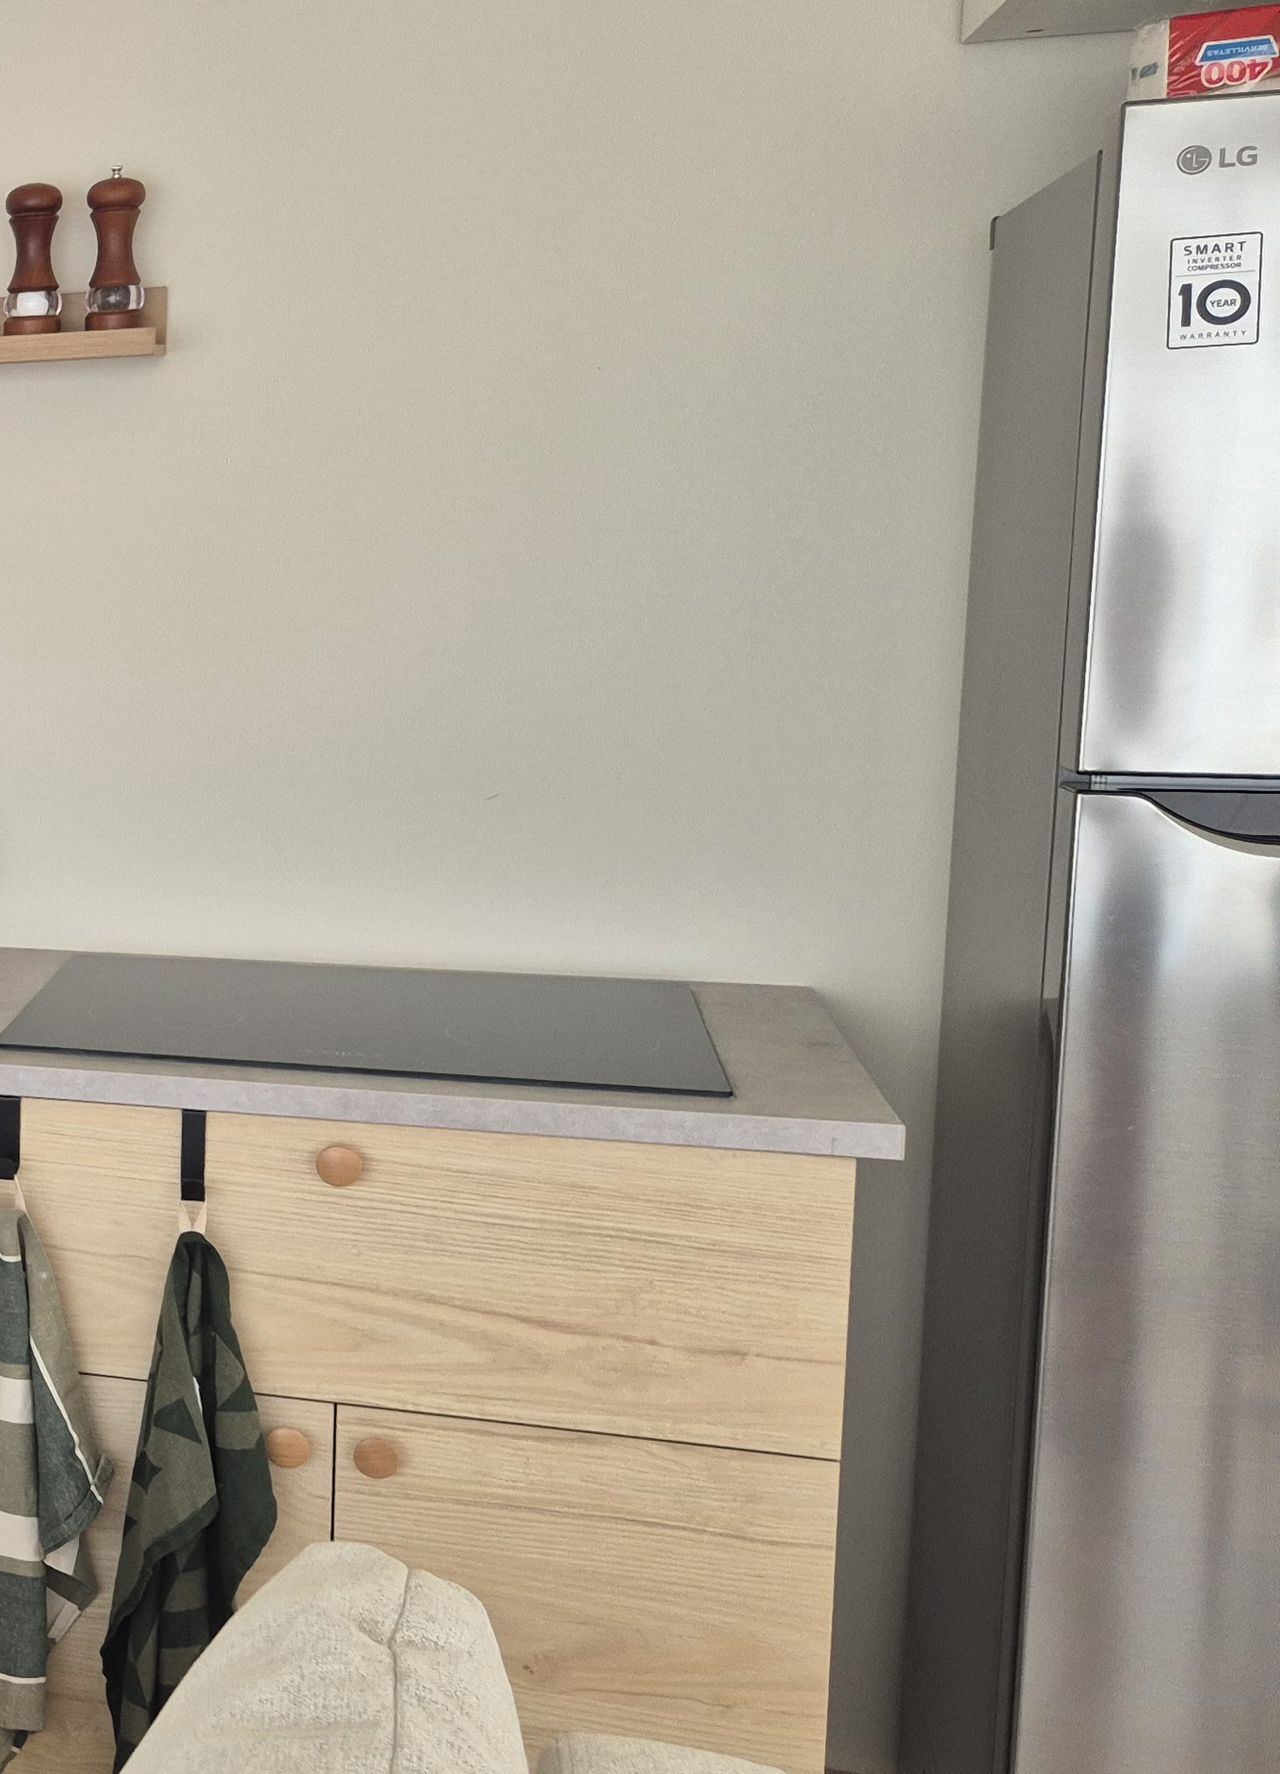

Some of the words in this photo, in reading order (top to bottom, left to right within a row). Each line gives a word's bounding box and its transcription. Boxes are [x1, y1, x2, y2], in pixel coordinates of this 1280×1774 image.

[1205, 59, 1269, 85] 400
[1219, 146, 1258, 168] LG
[1184, 241, 1246, 256] SMART
[1187, 255, 1242, 264] INVERTER
[1187, 262, 1242, 272] COMPRESSOR
[1178, 279, 1251, 327] 10
[1209, 298, 1237, 308] YEAR
[1180, 330, 1246, 340] WARRANTY
